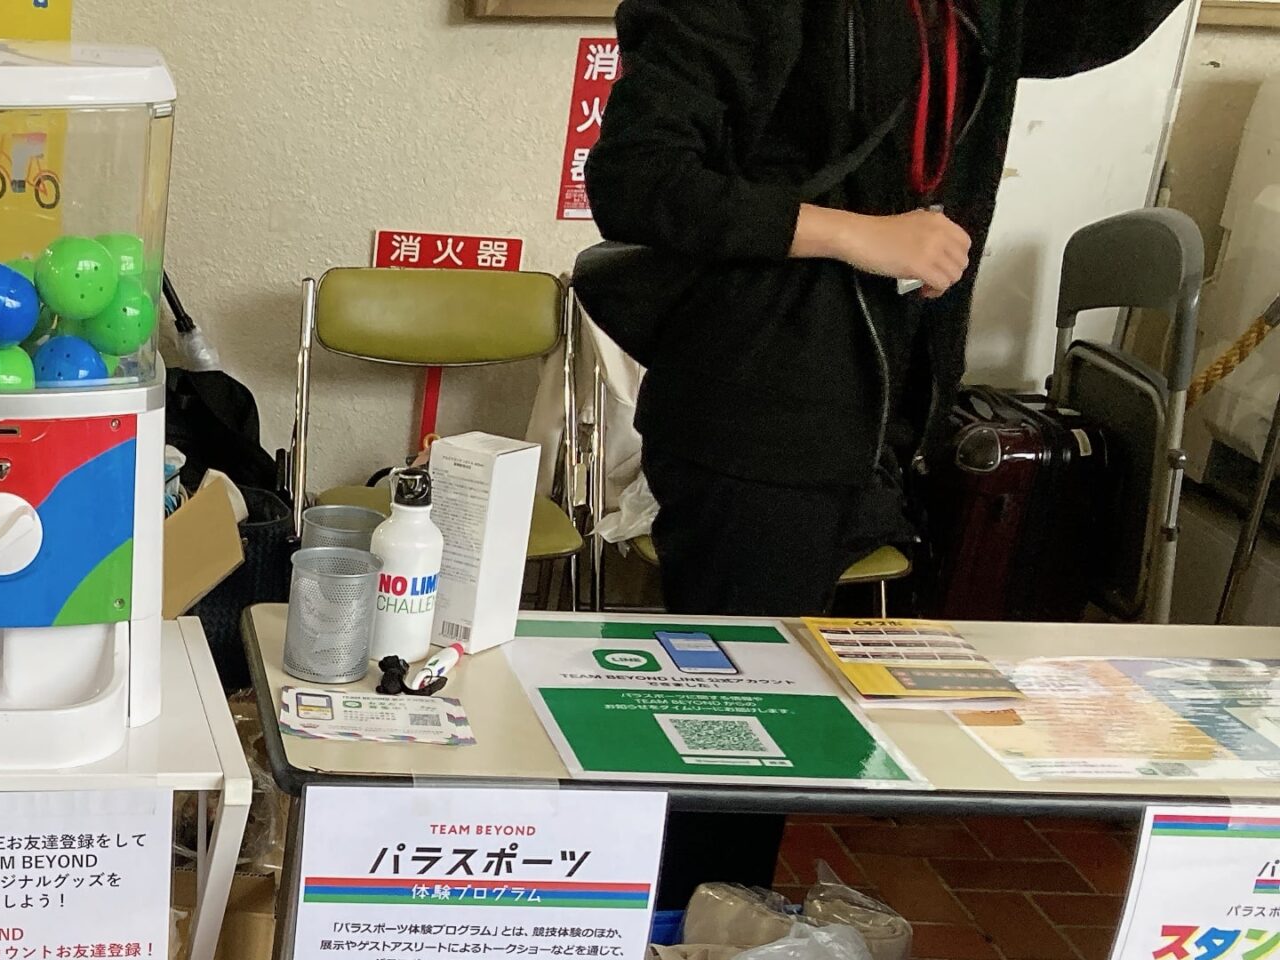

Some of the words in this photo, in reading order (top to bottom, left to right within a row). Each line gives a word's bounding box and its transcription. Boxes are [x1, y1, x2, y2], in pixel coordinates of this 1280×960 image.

[390, 234, 508, 267] 消火器
[378, 573, 408, 596] NO
[410, 573, 440, 596] LIM
[430, 824, 470, 836] TEAM
[476, 825, 536, 836] BEYOND
[22, 854, 98, 869] BEYOND
[369, 843, 592, 878] パラスポーツ
[411, 883, 542, 903] 体験プログラム
